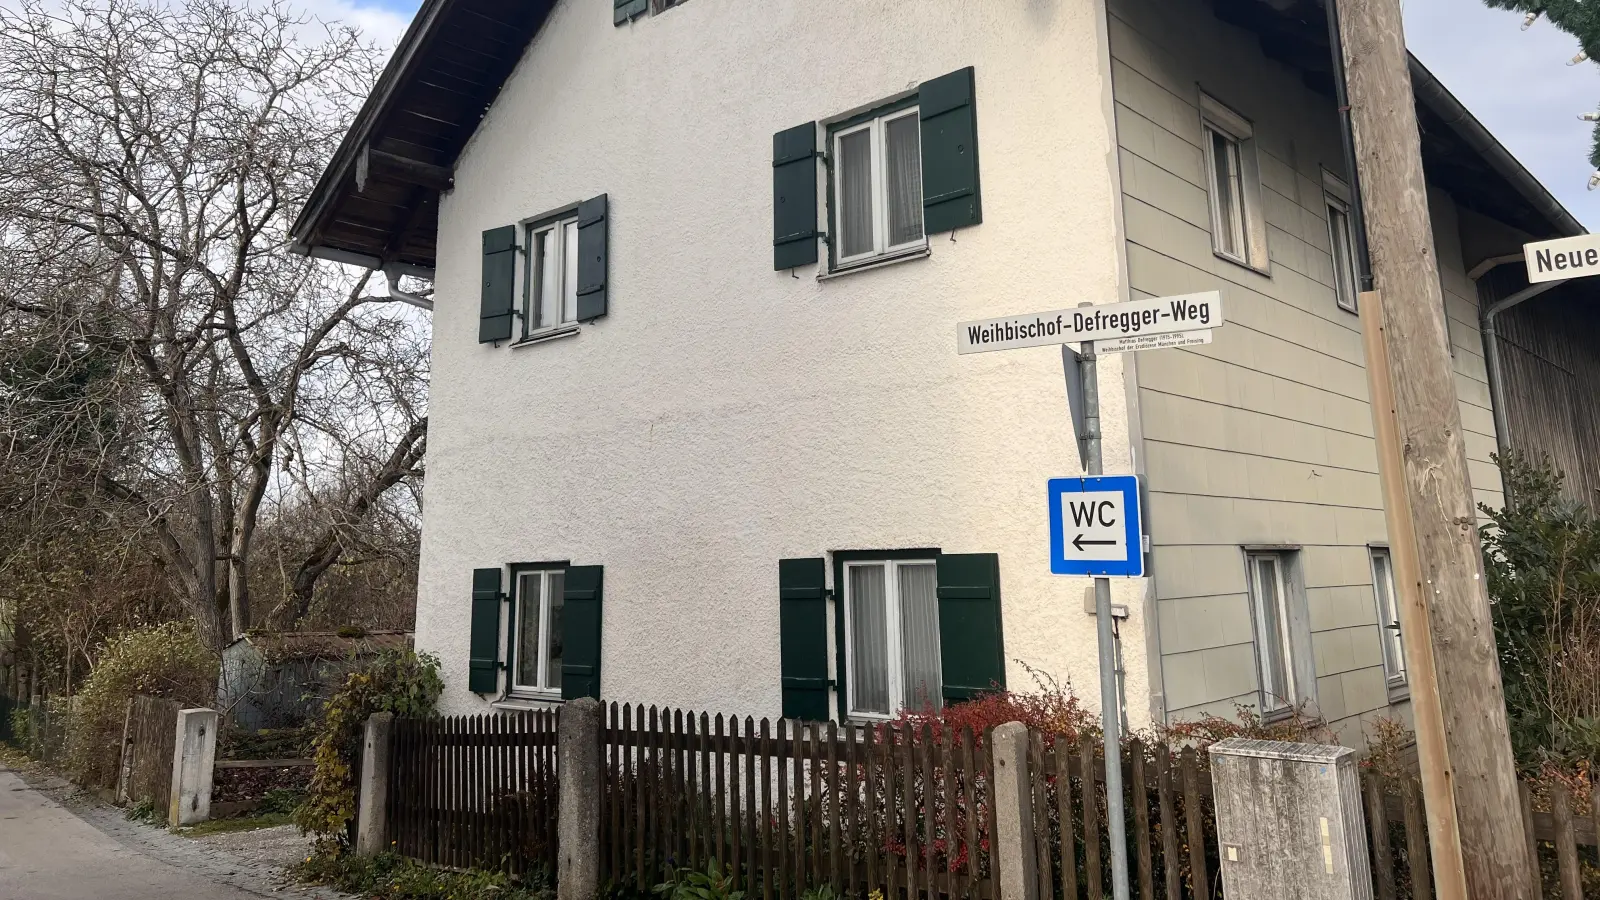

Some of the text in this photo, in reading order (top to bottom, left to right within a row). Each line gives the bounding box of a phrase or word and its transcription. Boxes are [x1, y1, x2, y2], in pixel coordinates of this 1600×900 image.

[1536, 248, 1599, 272] Neue
[968, 299, 1210, 344] Weihbischof-Defregger-Weg
[1069, 500, 1116, 527] WC
